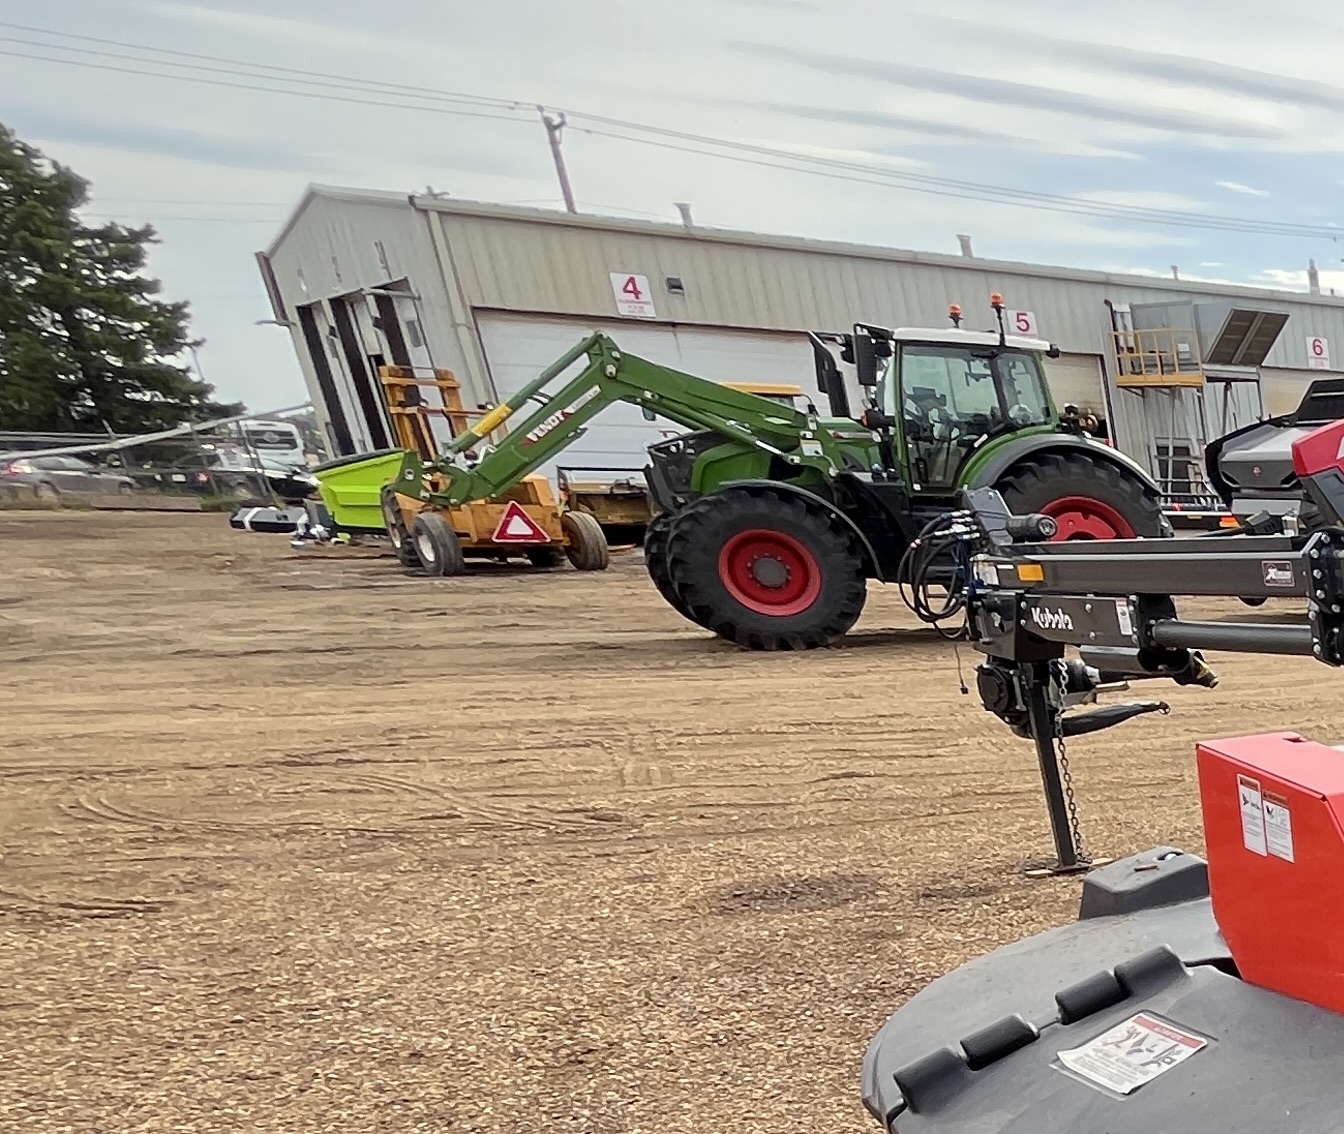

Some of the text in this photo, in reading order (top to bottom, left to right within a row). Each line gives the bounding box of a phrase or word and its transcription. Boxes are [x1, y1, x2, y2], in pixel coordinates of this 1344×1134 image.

[622, 276, 644, 300] 4
[1015, 312, 1031, 332] 5
[1312, 338, 1324, 356] 6
[1030, 607, 1074, 630] Kubota
